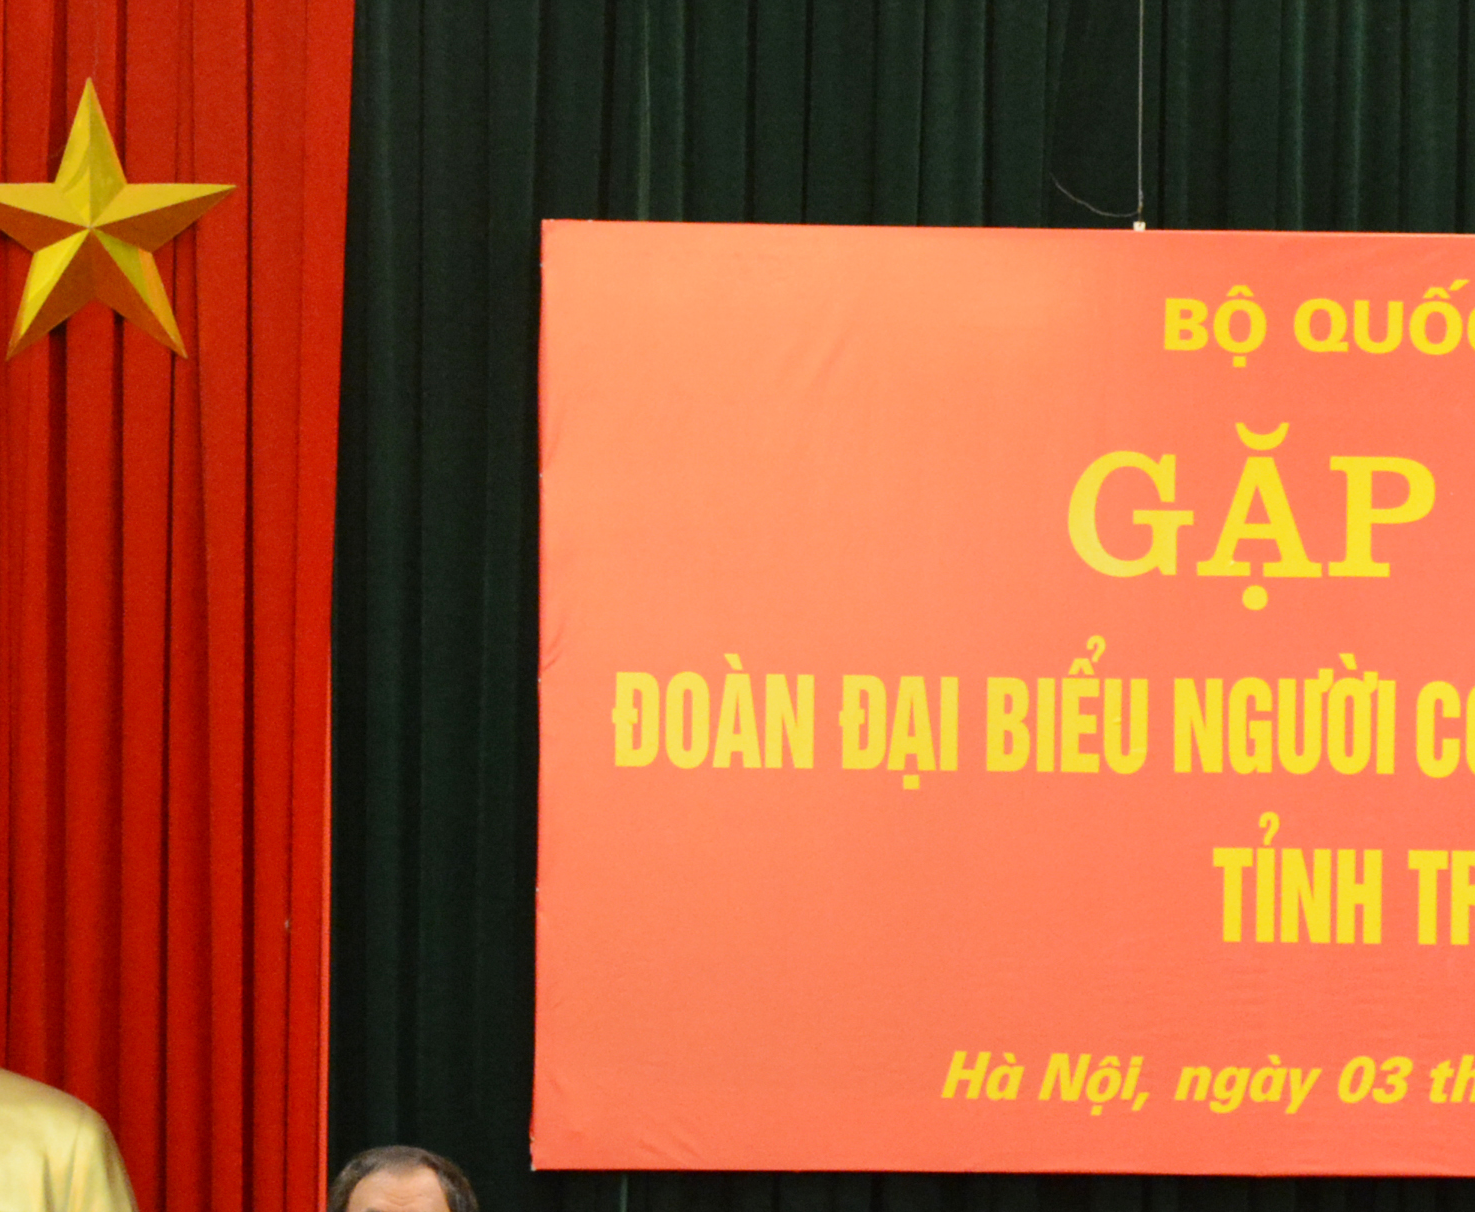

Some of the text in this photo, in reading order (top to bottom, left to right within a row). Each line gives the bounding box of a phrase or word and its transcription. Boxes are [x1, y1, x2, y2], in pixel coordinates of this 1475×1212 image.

[1165, 286, 1266, 367] BỘ
[1068, 423, 1435, 610] GẶP
[612, 654, 815, 769] ĐOÀN
[839, 675, 959, 789] ĐẠI
[987, 636, 1148, 774] BIỂU
[1175, 654, 1395, 774] NGƯỜI
[1214, 812, 1382, 943] TỈNH
[943, 1052, 1024, 1100] Hà
[1040, 1054, 1148, 1115] Nội,
[1176, 1055, 1321, 1113] ngày
[1339, 1057, 1413, 1103] 03
